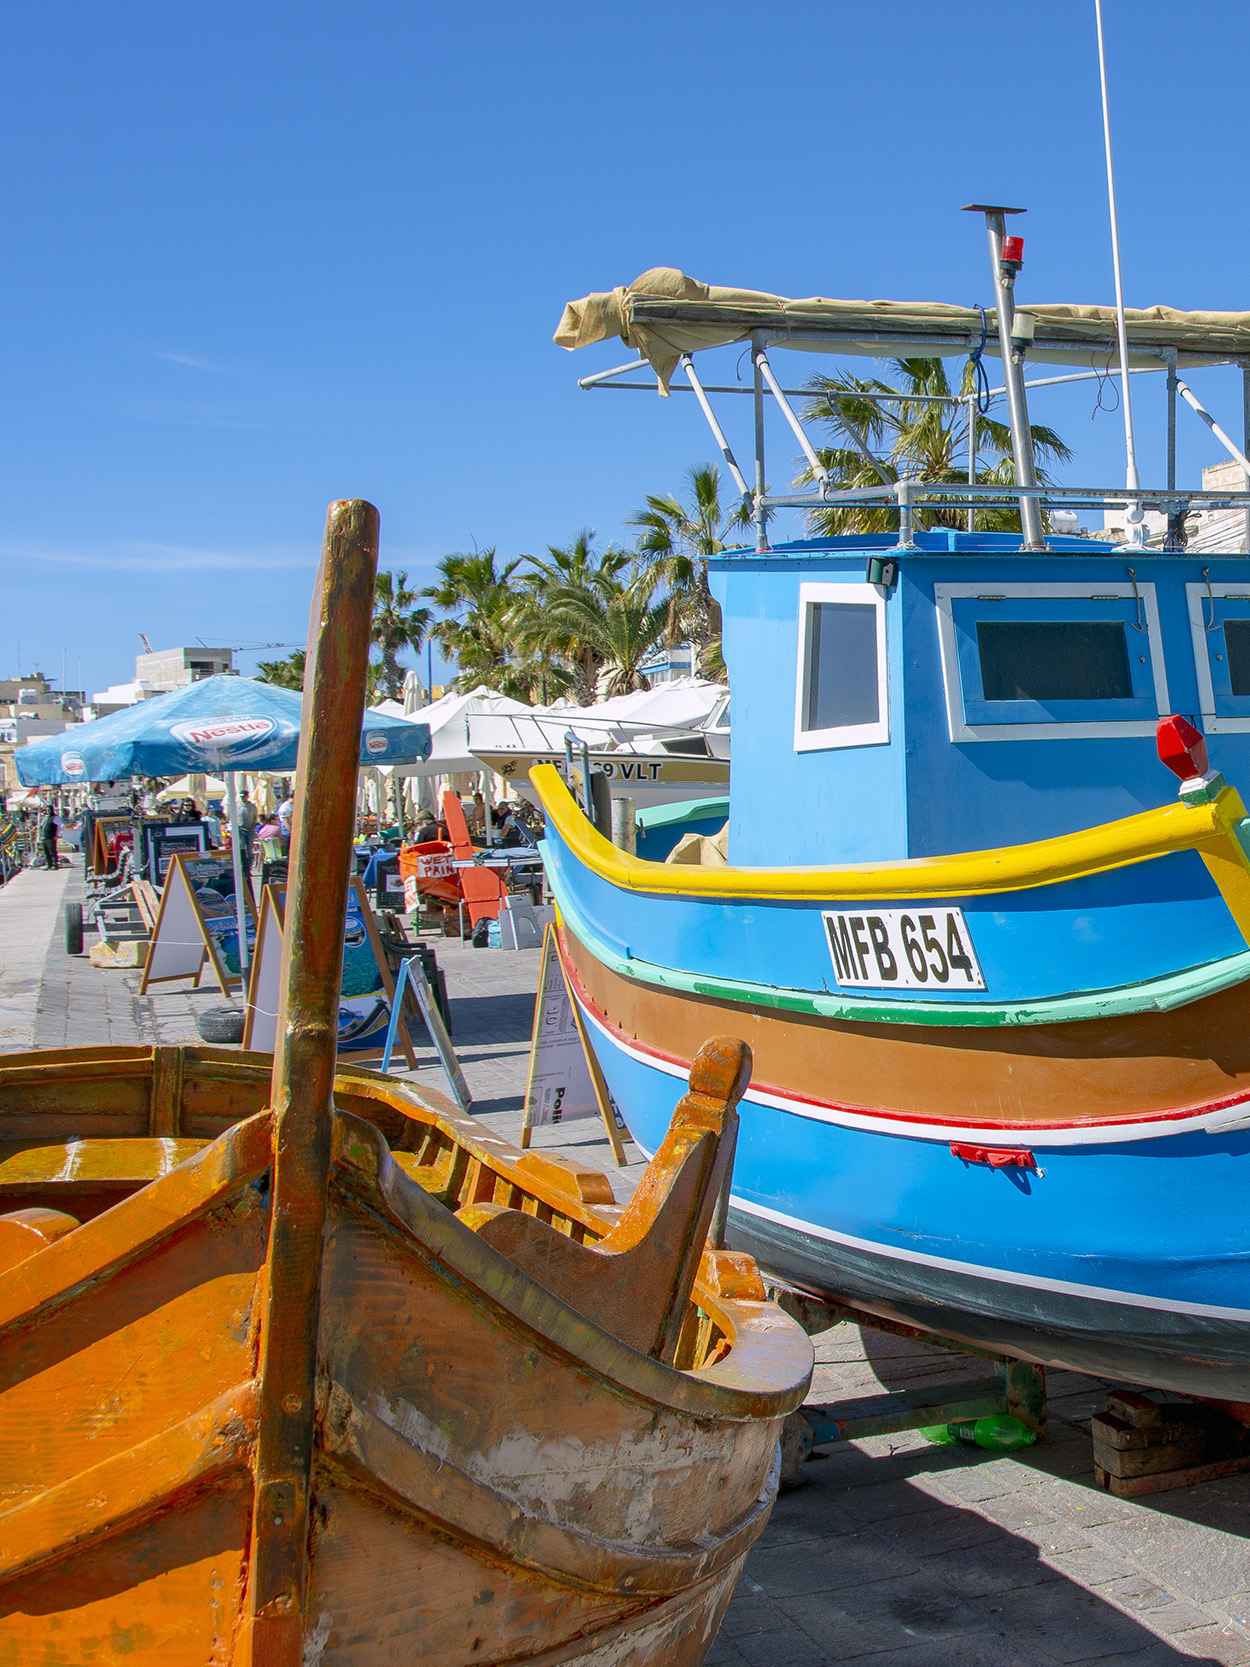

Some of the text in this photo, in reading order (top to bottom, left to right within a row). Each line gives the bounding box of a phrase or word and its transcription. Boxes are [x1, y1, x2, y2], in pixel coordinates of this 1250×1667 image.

[619, 762, 662, 780] VLT
[420, 854, 453, 866] WET
[826, 912, 974, 984] MFB 654
